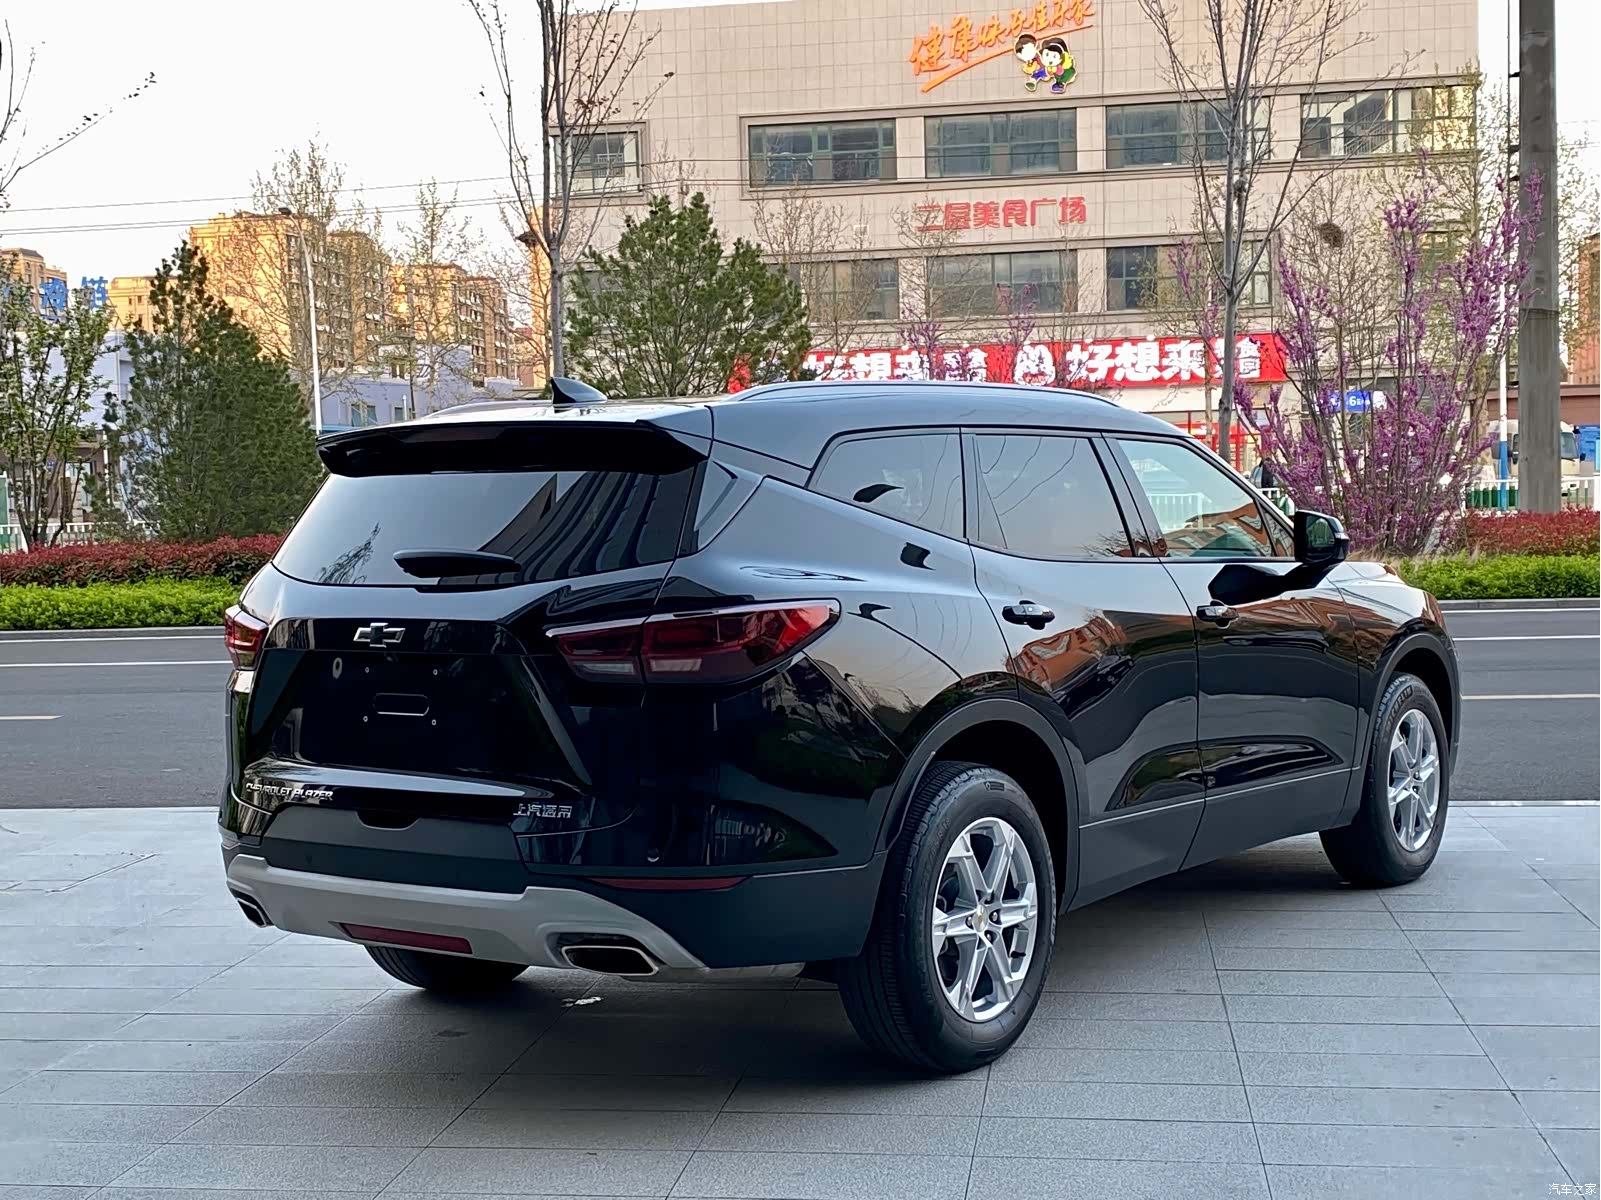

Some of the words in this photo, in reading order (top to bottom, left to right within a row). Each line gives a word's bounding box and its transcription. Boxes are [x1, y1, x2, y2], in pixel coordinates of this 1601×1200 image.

[917, 196, 1087, 232] 二层美食广场
[292, 787, 334, 801] BLAZER
[513, 801, 573, 819] 上汽通用
